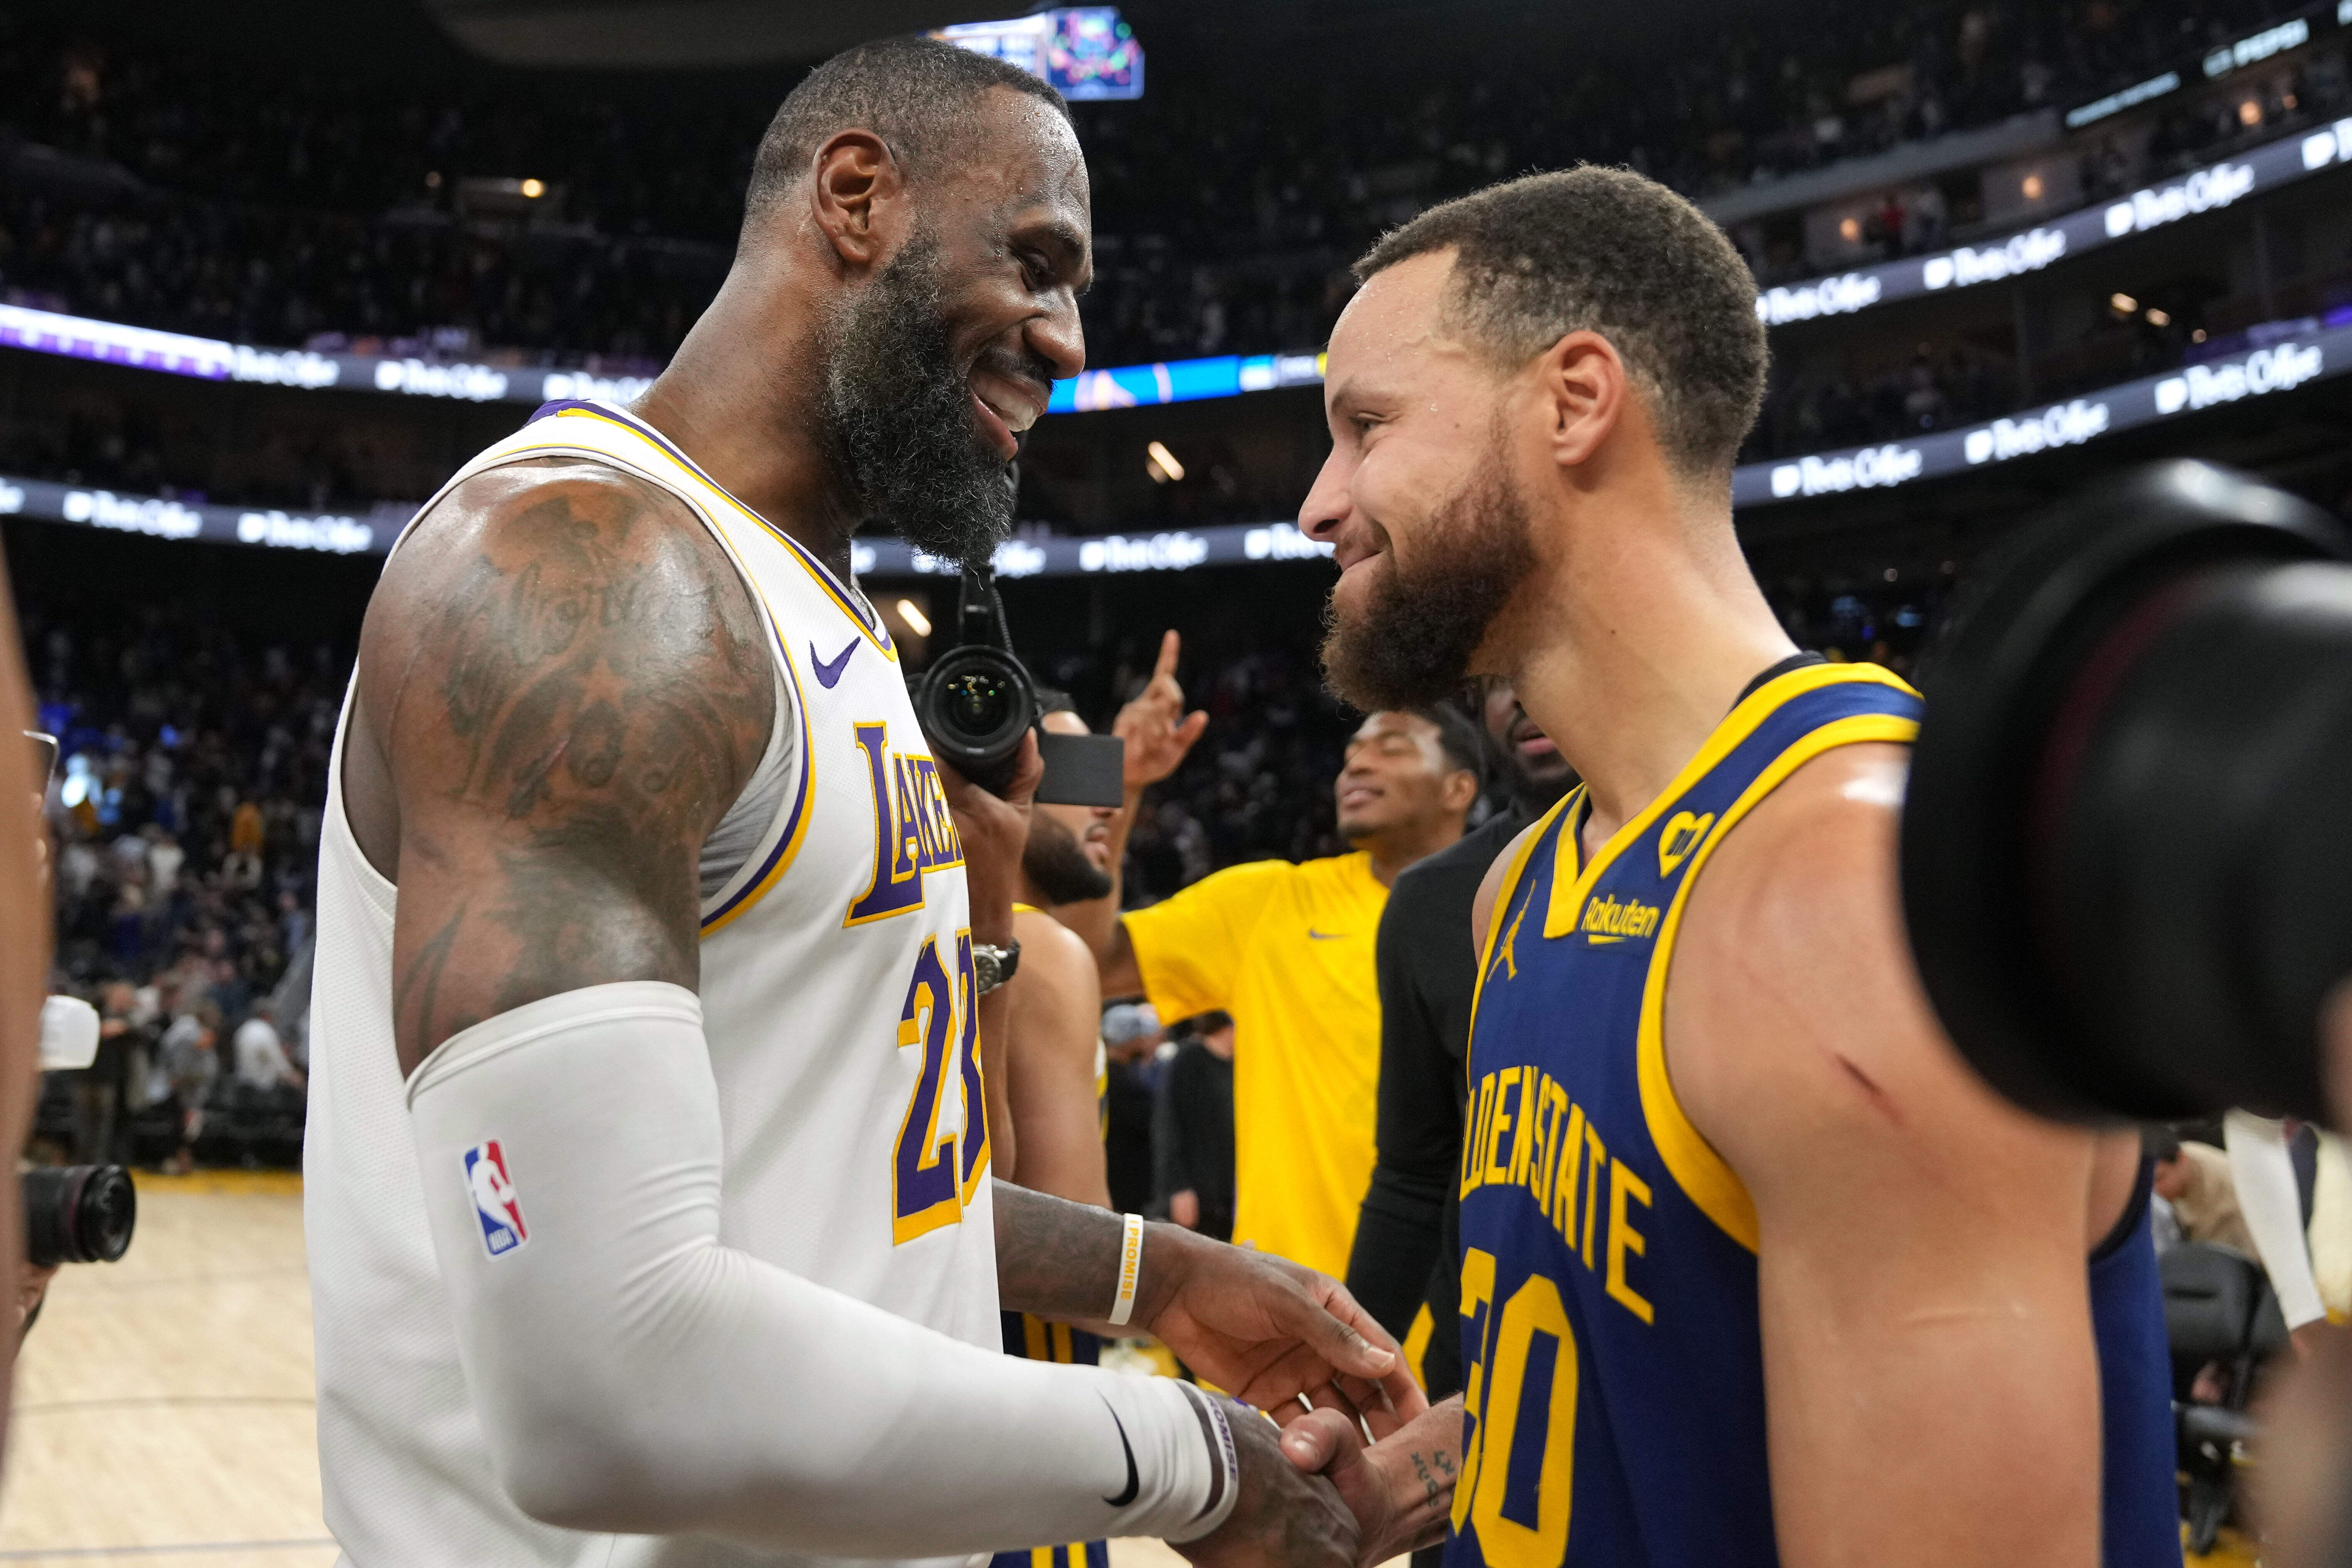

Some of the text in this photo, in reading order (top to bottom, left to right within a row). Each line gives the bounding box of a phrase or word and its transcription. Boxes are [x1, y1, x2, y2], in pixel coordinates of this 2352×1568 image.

[843, 721, 966, 928] LAKE
[1581, 893, 1660, 939] Rakuten
[892, 927, 991, 1246] 23
[1120, 1228, 1139, 1300] PROMISE
[1206, 1396, 1237, 1481] ROMISE
[1450, 1247, 1579, 1568] 30
